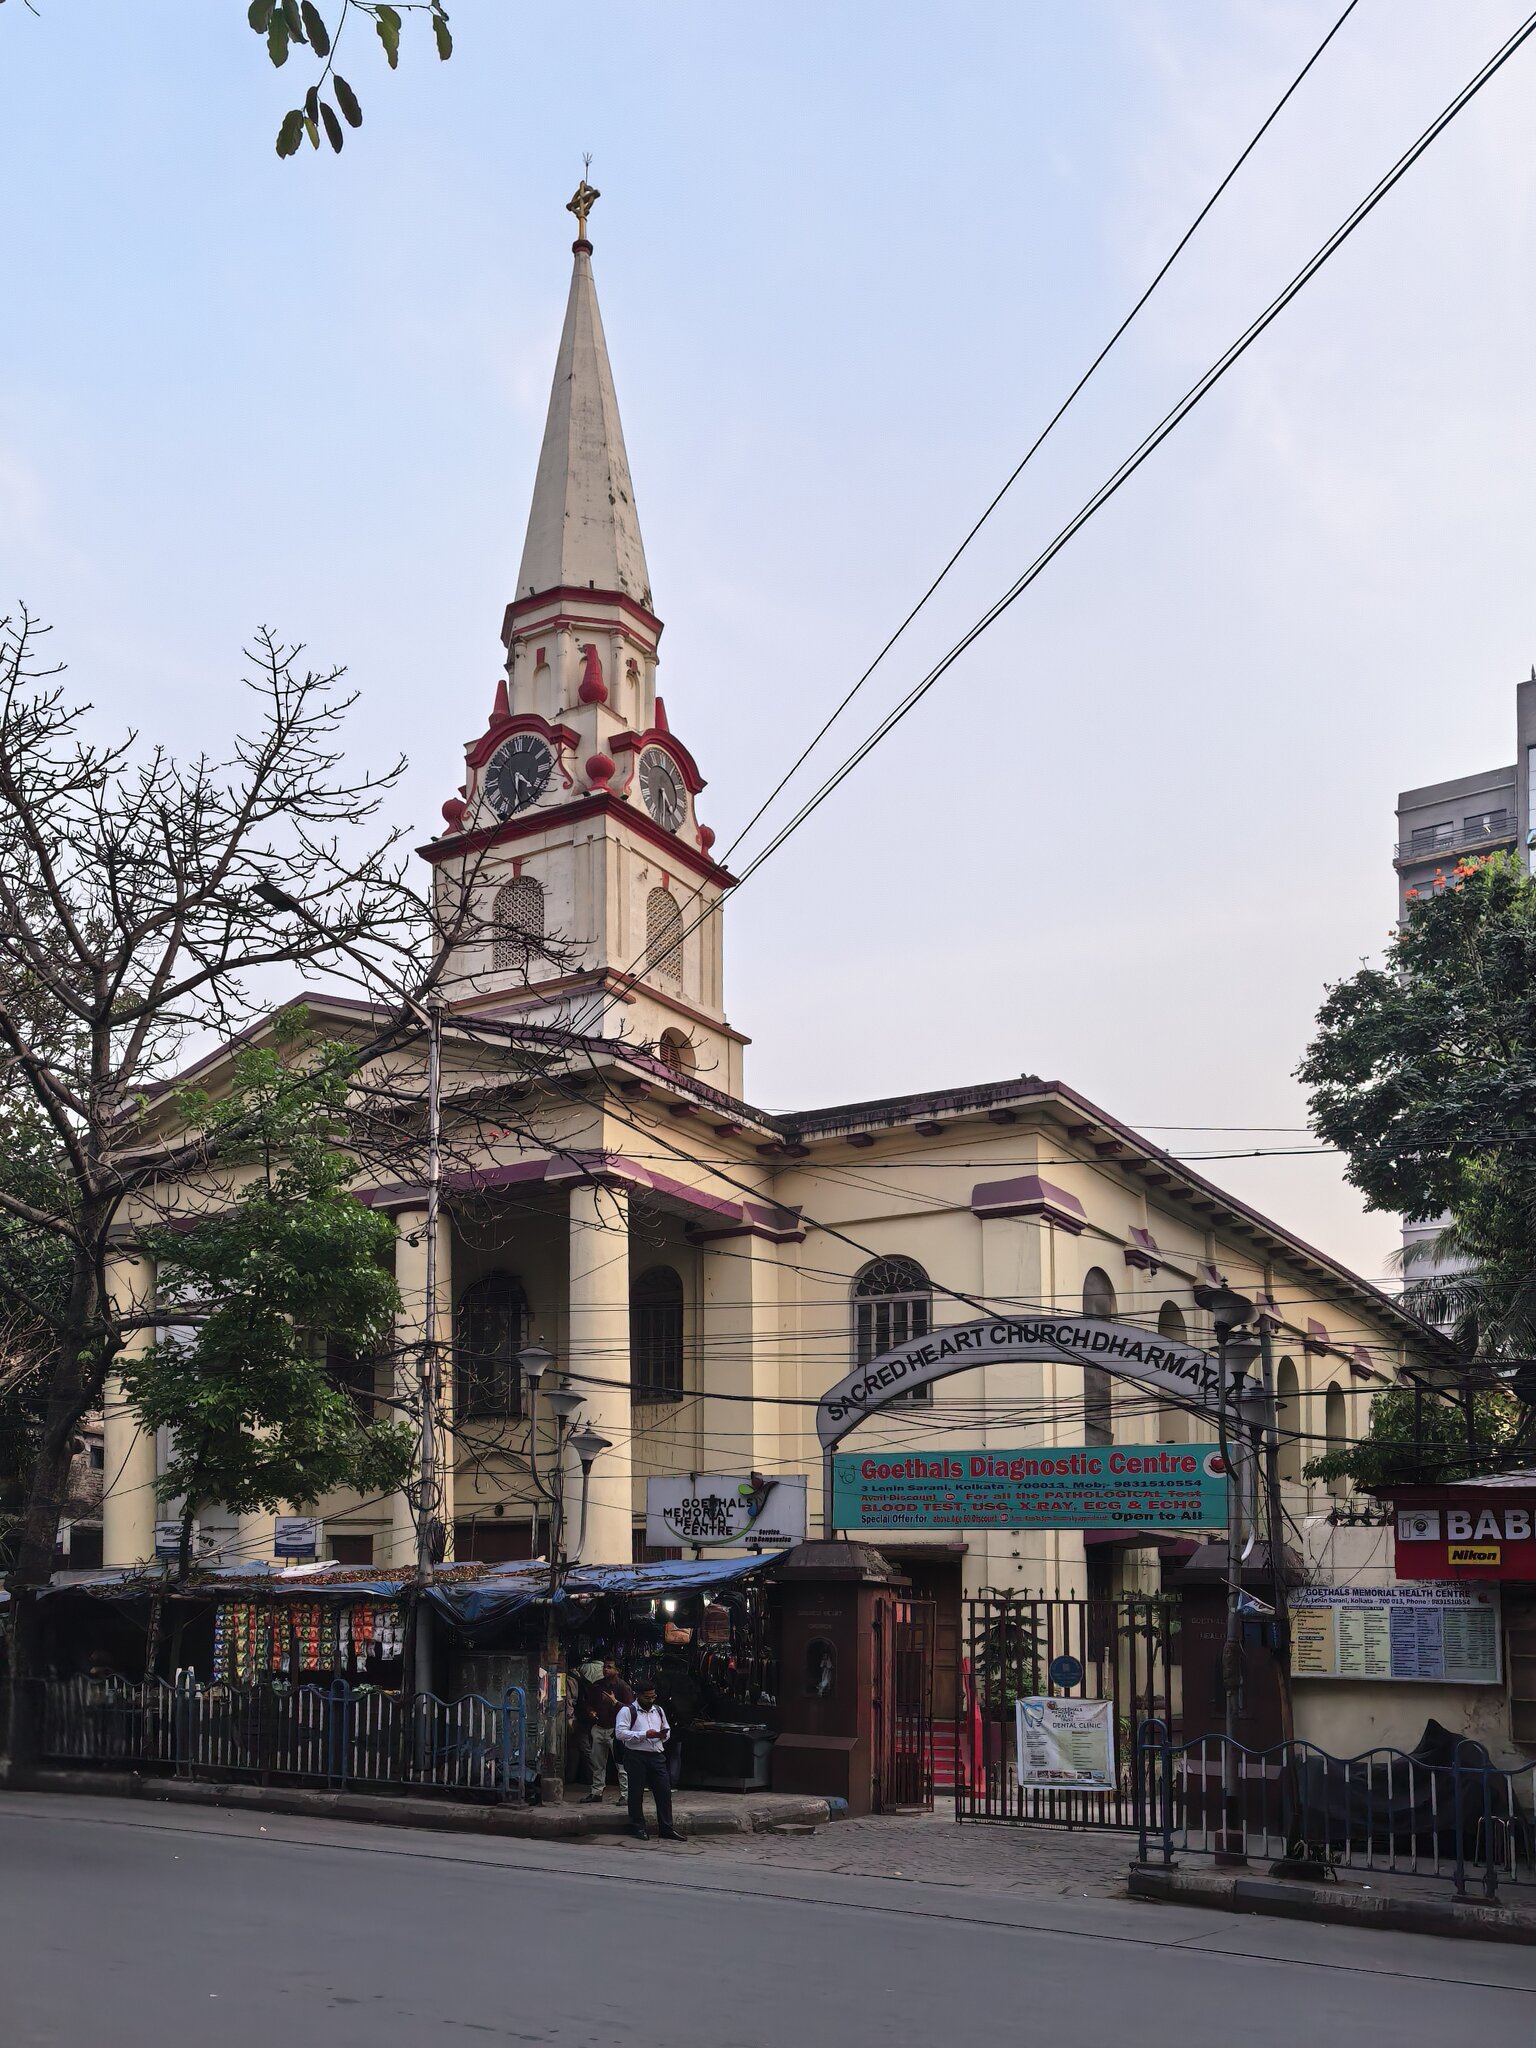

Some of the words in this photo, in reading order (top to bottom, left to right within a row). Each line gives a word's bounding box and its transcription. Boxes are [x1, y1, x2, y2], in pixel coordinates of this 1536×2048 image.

[828, 1359, 907, 1421] SACRED
[906, 1327, 984, 1371] HEART
[990, 1324, 1091, 1349] CHURCH
[861, 1457, 963, 1480] Goethals
[970, 1453, 1102, 1481] Diagnostic
[1109, 1452, 1197, 1474] Centre
[1114, 1480, 1202, 1488] 9831510554
[862, 1503, 918, 1512] BLOOD
[1083, 1501, 1121, 1510] ECG
[1127, 1500, 1142, 1509] &
[1148, 1500, 1202, 1510] ECHO
[675, 1517, 726, 1526] HEALTH
[861, 1514, 890, 1524] Special
[892, 1513, 914, 1523] Offer
[915, 1513, 928, 1523] for
[1111, 1511, 1154, 1522] Open
[1158, 1511, 1176, 1520] to
[1180, 1510, 1203, 1520] All
[682, 1526, 733, 1535] CENTRE
[1446, 1509, 1536, 1540] BAB
[1452, 1549, 1497, 1561] Nikon
[1306, 1588, 1350, 1596] GOETHALS
[1352, 1589, 1397, 1597] MEMORIAL
[1399, 1589, 1433, 1597] HEALTH
[1435, 1590, 1471, 1598] CENTRE
